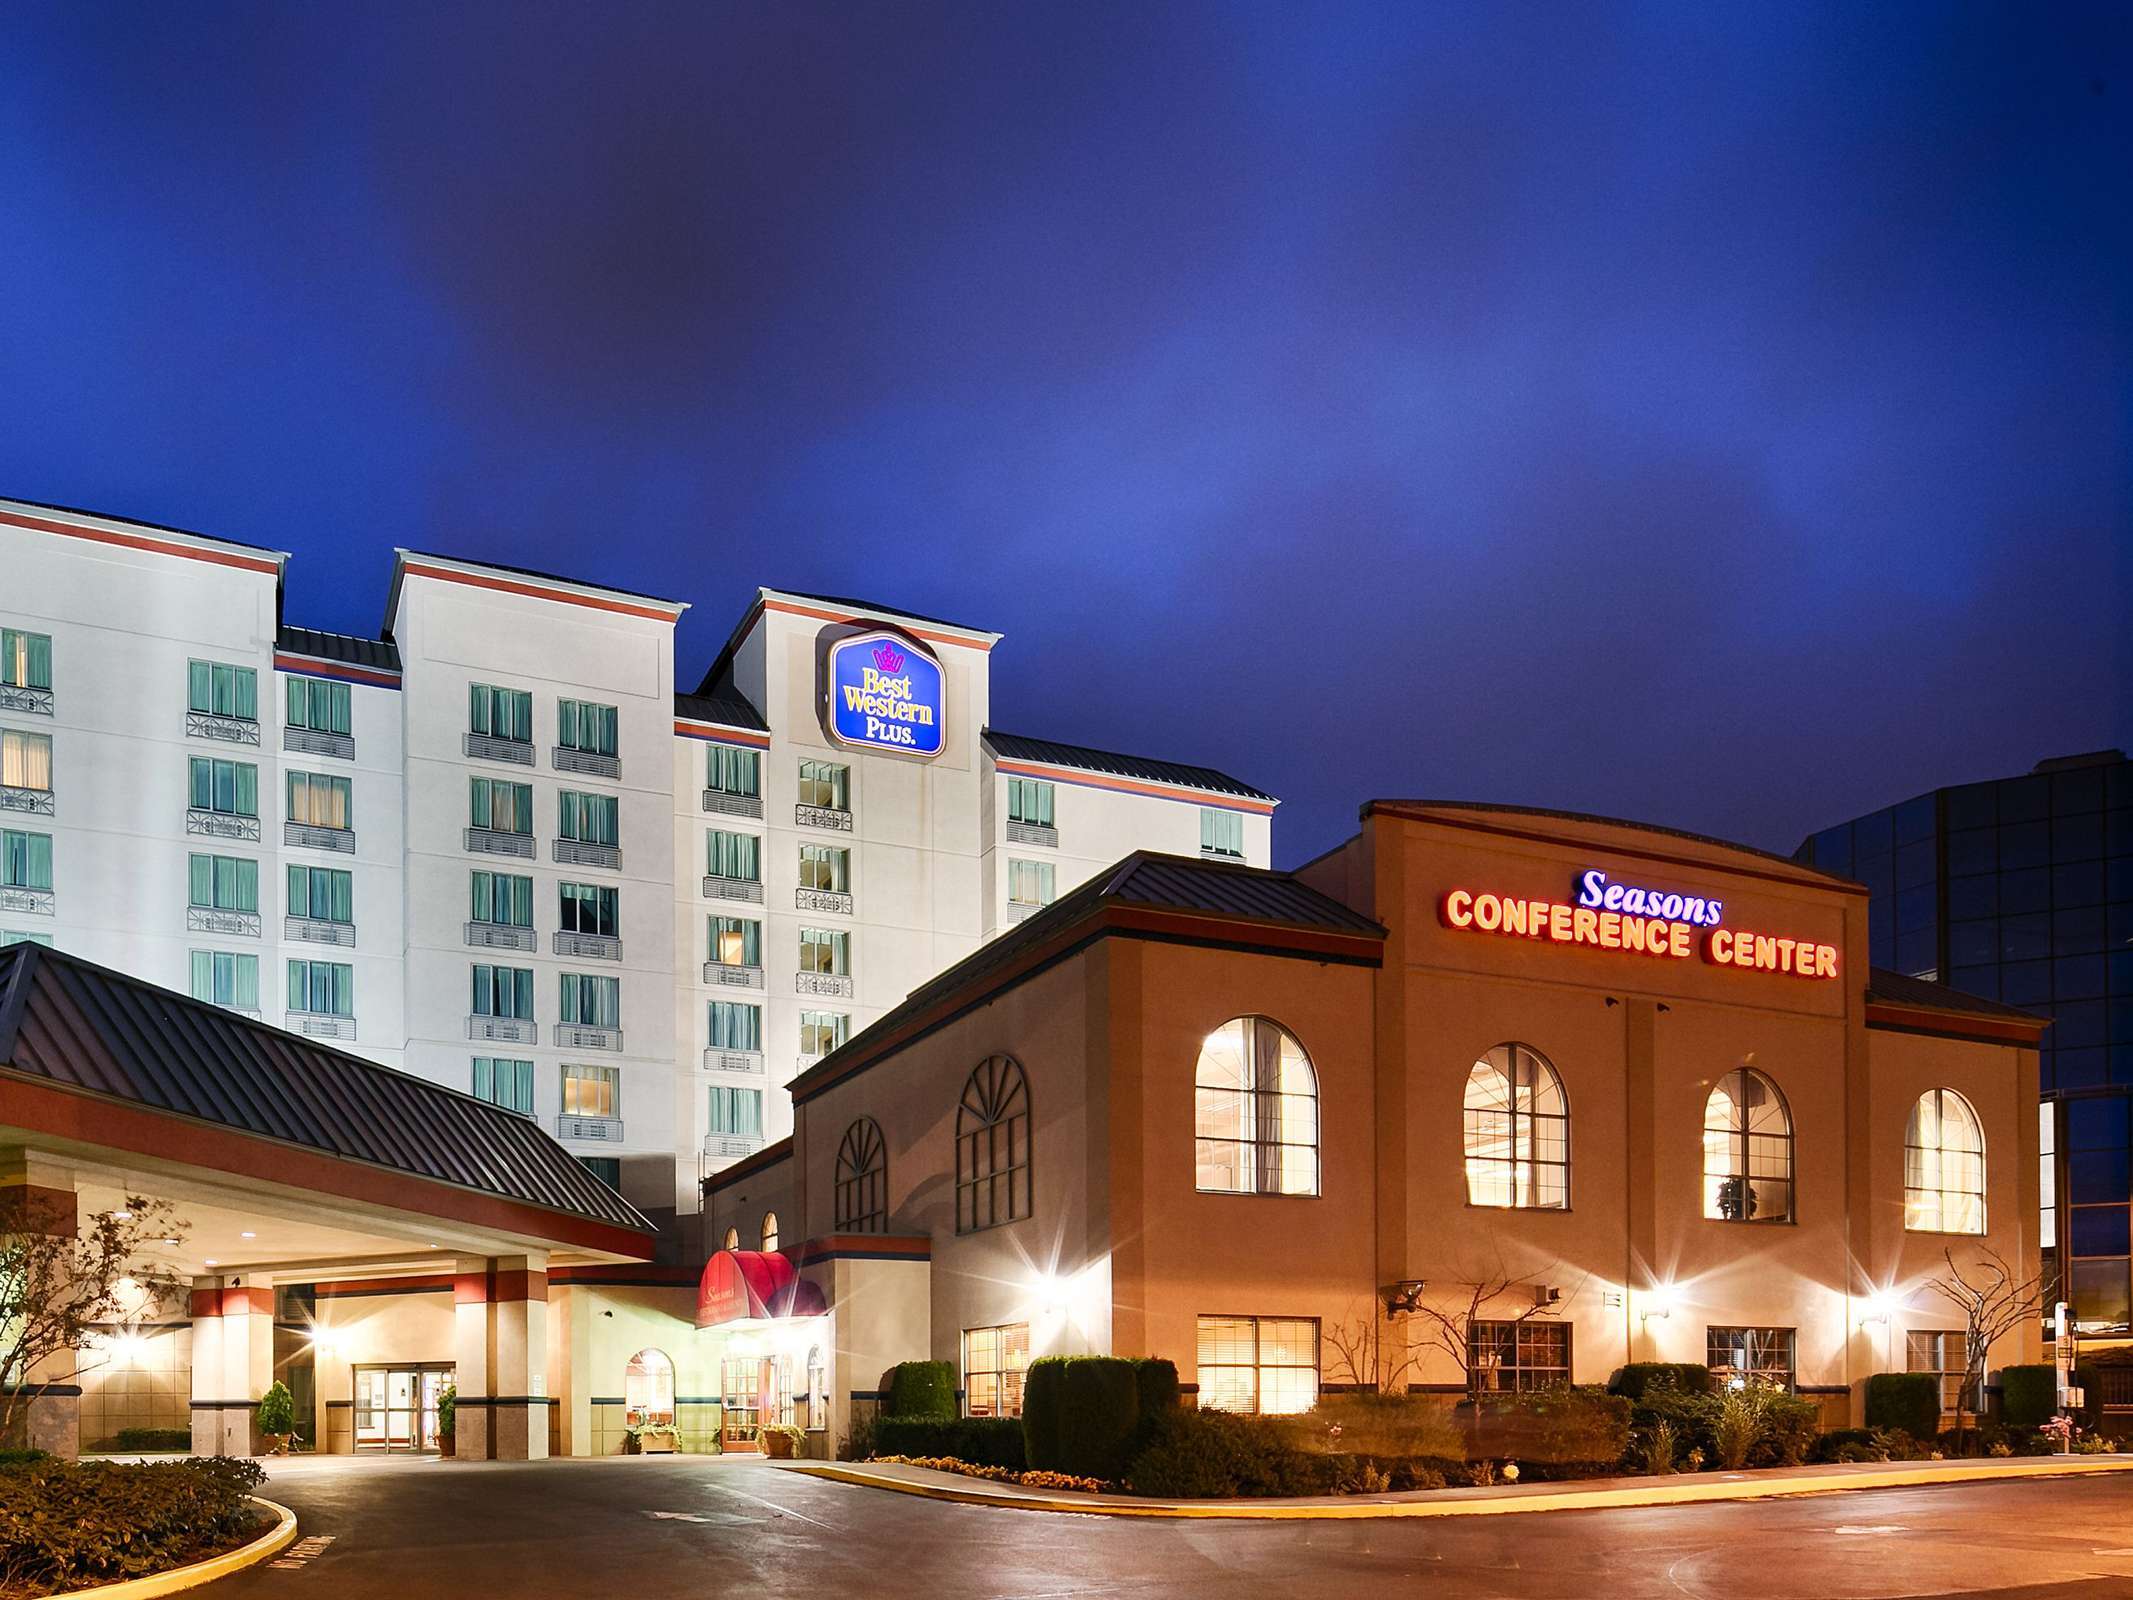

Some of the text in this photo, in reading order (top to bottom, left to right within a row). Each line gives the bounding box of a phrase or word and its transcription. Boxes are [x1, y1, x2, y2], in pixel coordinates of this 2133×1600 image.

[843, 685, 934, 726] Western
[862, 667, 912, 701] Best
[1579, 870, 1722, 926] Seasons
[1447, 890, 1837, 978] CONFERENCE CENTER
